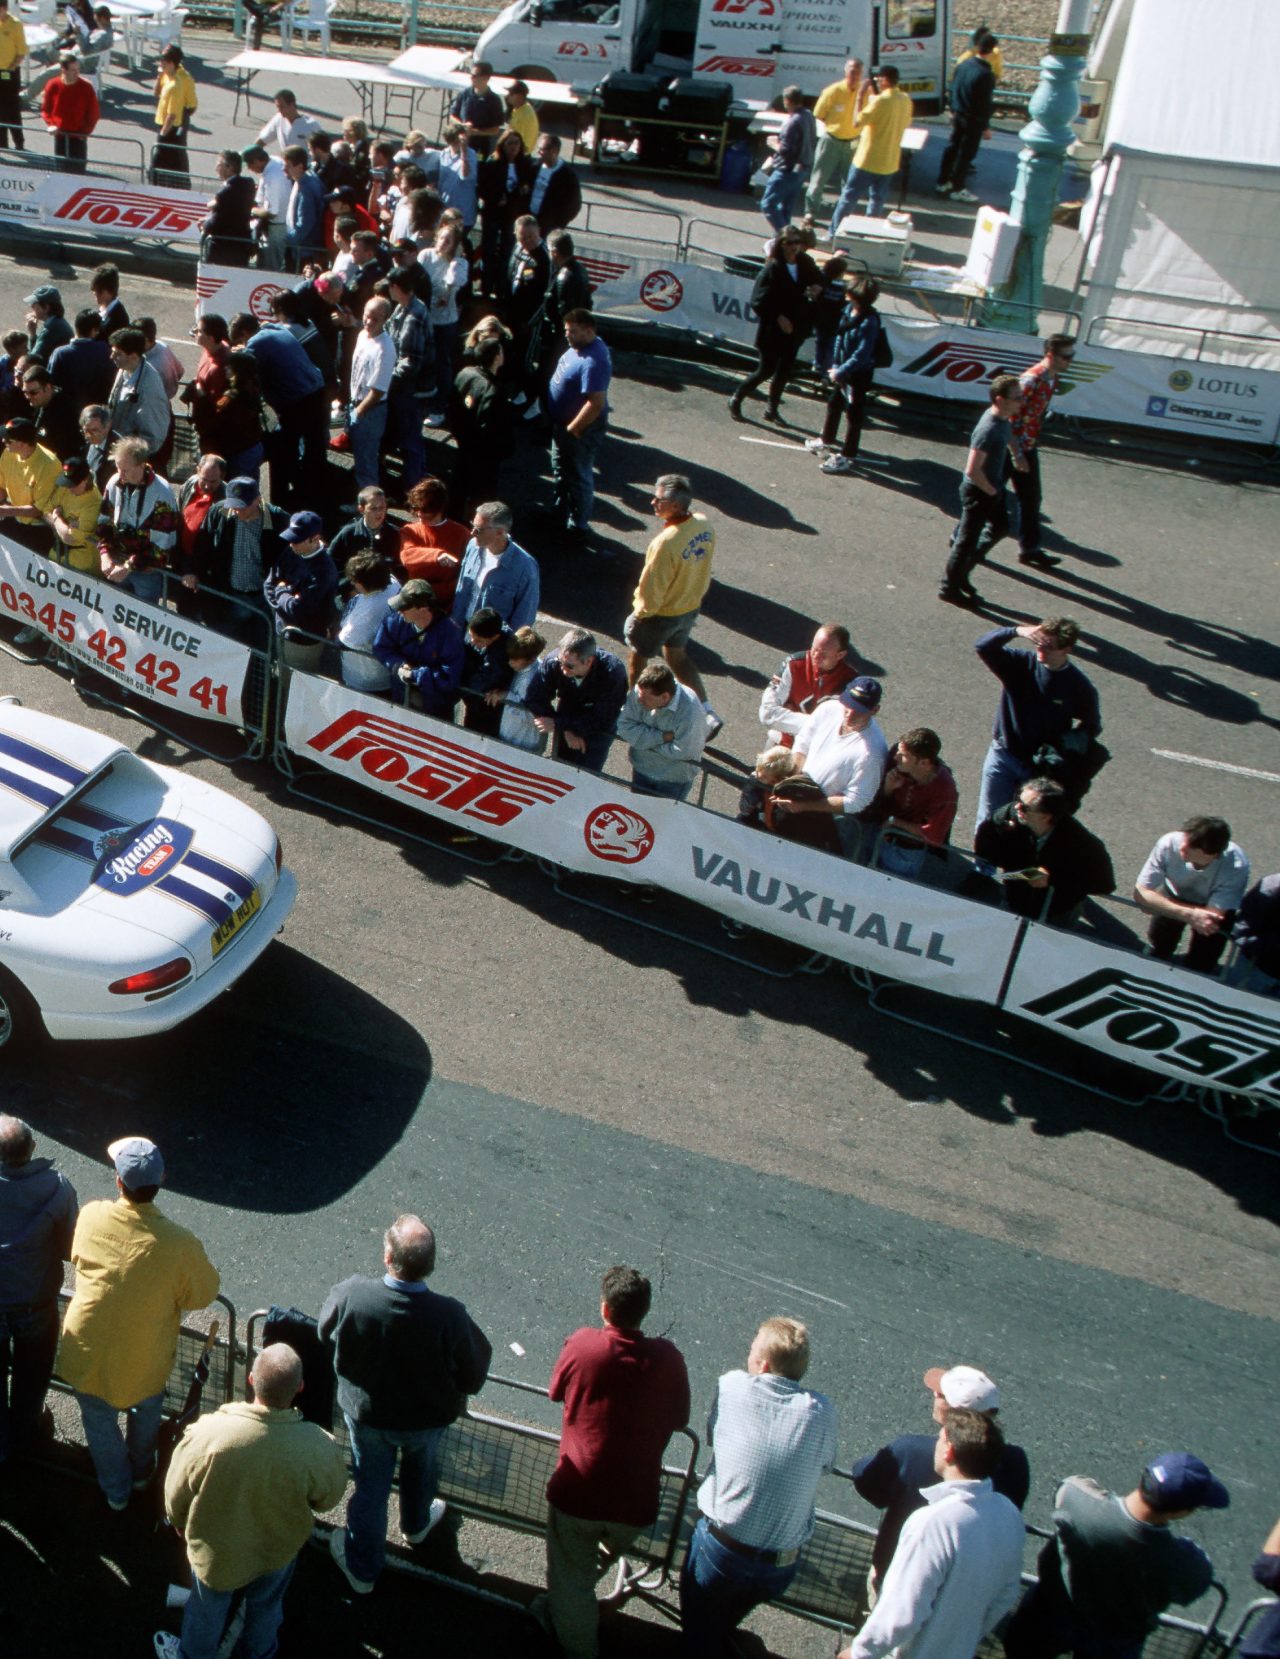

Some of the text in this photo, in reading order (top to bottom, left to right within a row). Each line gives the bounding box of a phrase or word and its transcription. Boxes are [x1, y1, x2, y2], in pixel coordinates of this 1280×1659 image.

[1169, 404, 1232, 420] CHRYSLER
[1198, 378, 1258, 398] LOTUS
[26, 563, 202, 658] LO-CALL SERVICE
[0, 582, 228, 716] 0345 42 42 41
[105, 824, 174, 884] Racing
[143, 849, 169, 870] TEAM
[691, 845, 955, 967] VAUXHALL
